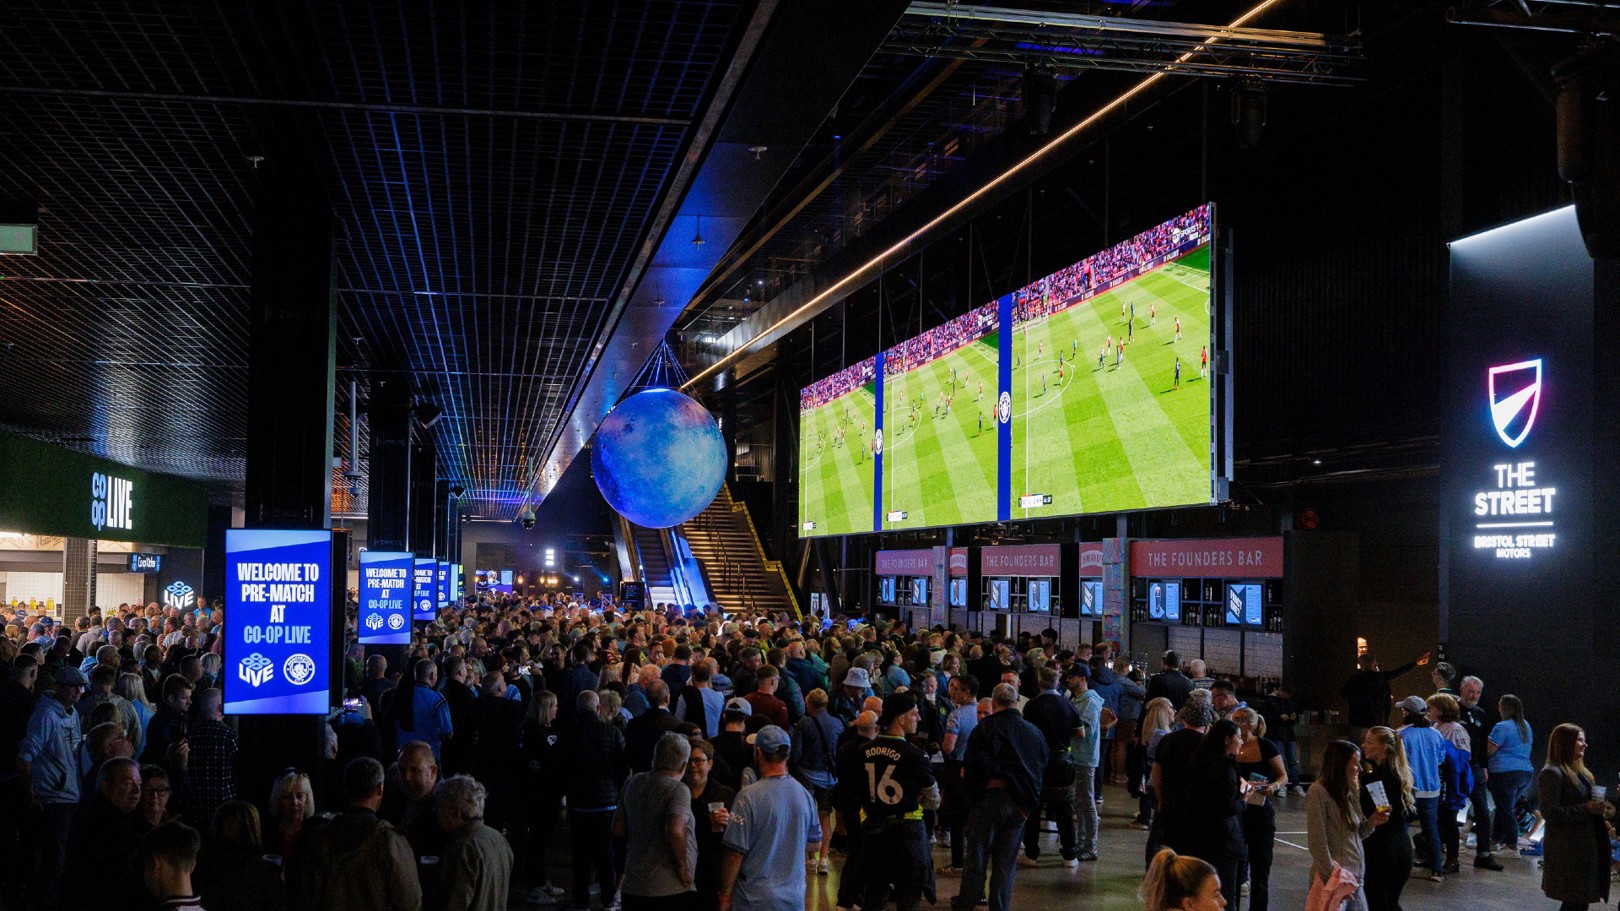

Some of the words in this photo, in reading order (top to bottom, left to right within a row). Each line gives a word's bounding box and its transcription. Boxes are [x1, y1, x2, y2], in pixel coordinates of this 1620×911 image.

[1494, 462, 1535, 488] THE
[107, 475, 133, 530] LIVE
[1475, 487, 1556, 515] STREET
[1474, 535, 1515, 549] BRISTOL
[1515, 533, 1556, 548] STREET
[986, 555, 998, 567] THE
[1000, 555, 1037, 567] FOUNDERS
[1040, 555, 1054, 567] BAR
[1148, 552, 1167, 567] THE
[1171, 551, 1233, 566] FOUNDERS
[1238, 550, 1263, 566] BAR
[1496, 548, 1531, 559] MOTORS
[237, 563, 302, 581] WELCOME
[303, 563, 319, 581] TO
[365, 568, 398, 578] WELCOME
[399, 568, 407, 578] TO
[367, 579, 405, 588] PRE-MATCH
[163, 589, 195, 610] LIVE
[241, 584, 314, 602] PRE-MATCH
[381, 589, 390, 599] AT
[368, 599, 388, 609] CO-OP
[388, 599, 403, 609] LIVE
[270, 604, 286, 623] AT
[365, 617, 384, 631] LIVE
[243, 625, 283, 644] CO-OP
[285, 626, 311, 644] LIVE
[238, 661, 274, 688] LIVE
[865, 745, 902, 762] RODRIGO
[864, 762, 904, 806] 16
